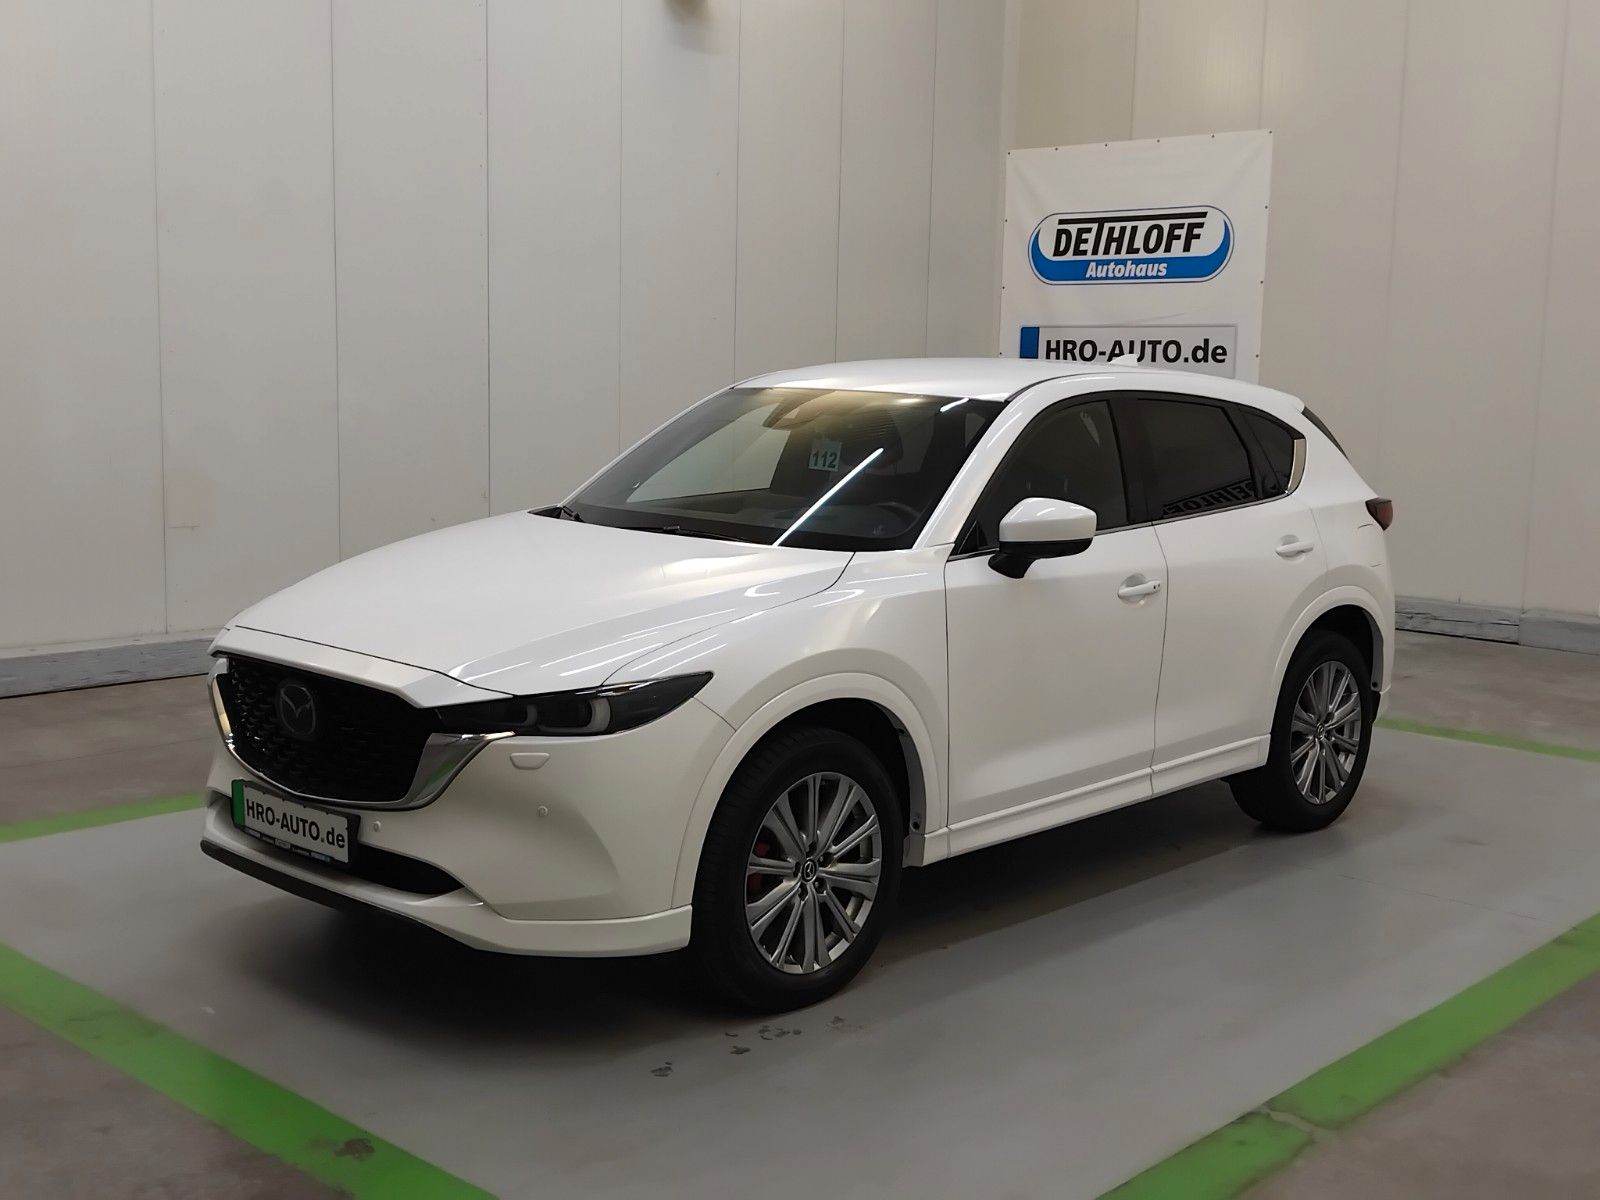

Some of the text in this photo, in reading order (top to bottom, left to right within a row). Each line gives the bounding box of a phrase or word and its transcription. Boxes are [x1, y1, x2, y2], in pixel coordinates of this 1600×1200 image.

[1053, 211, 1208, 257] DETHLOFF
[1086, 261, 1167, 278] Autohaus
[1045, 338, 1228, 363] HRO-AUTO.de
[812, 451, 837, 469] 112
[246, 798, 345, 848] HRO-AUTO.de
